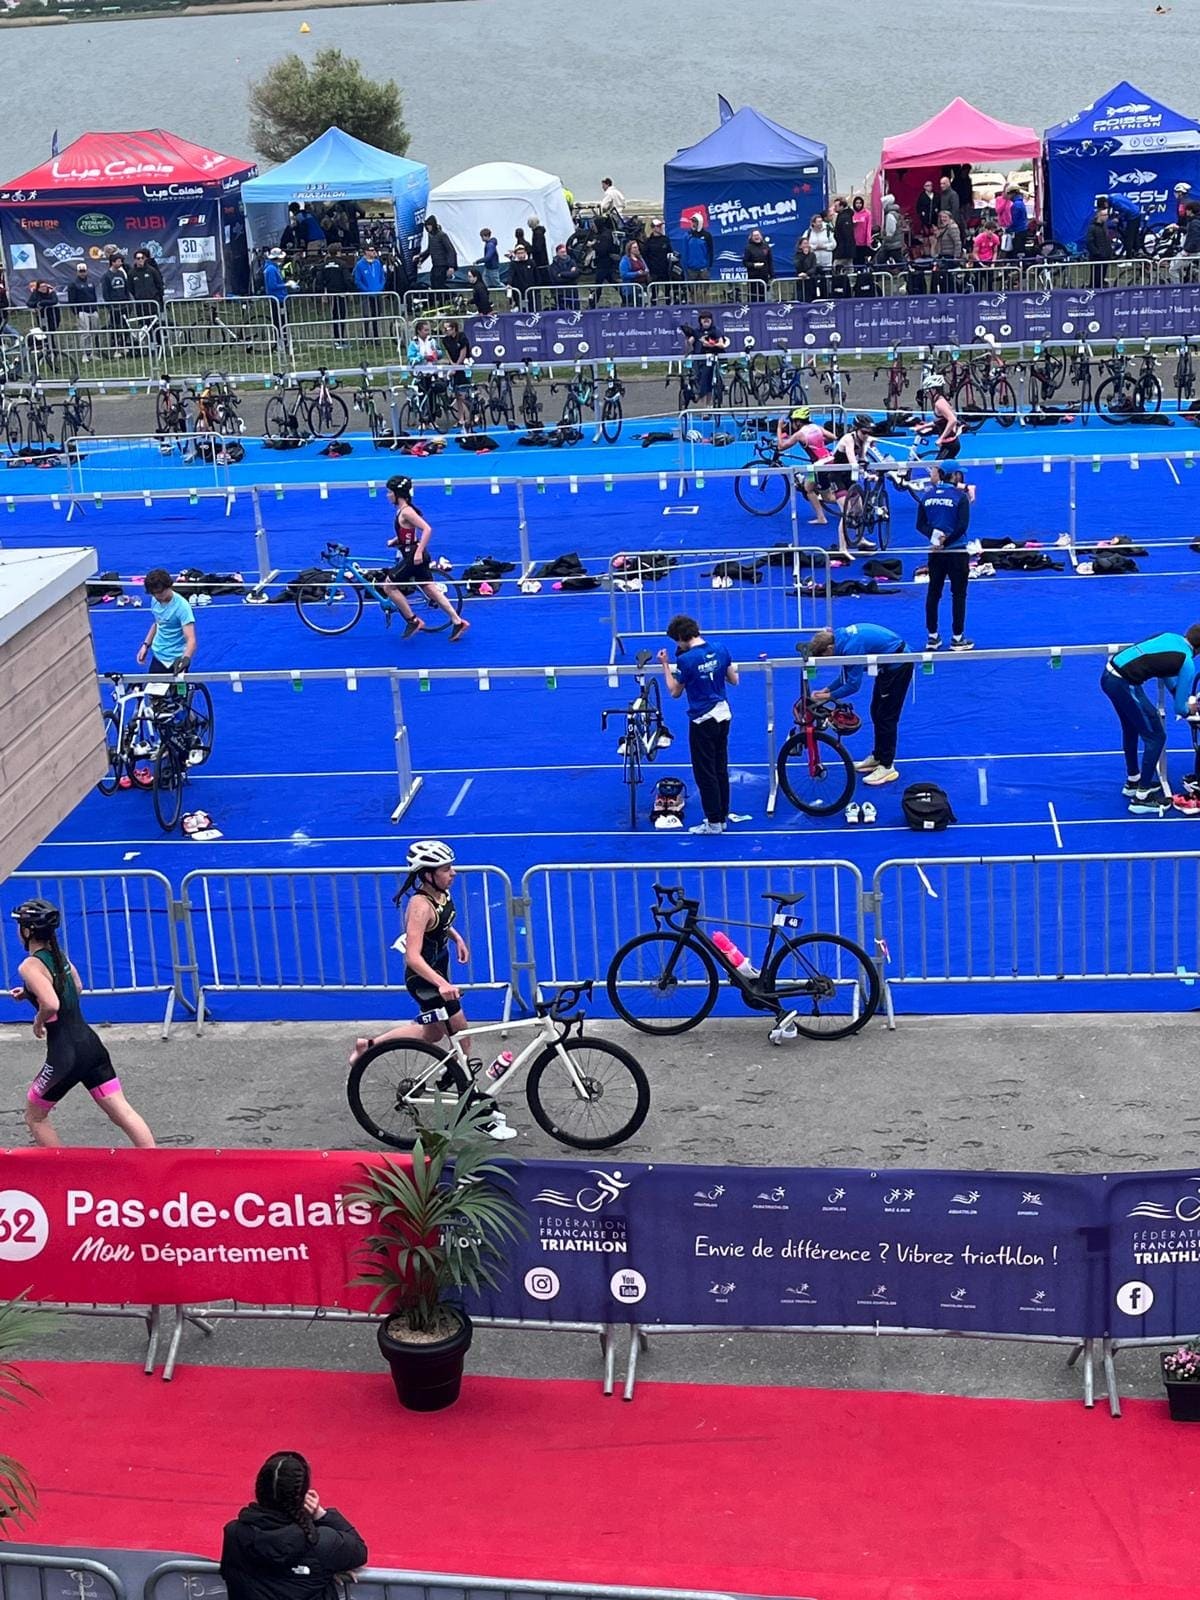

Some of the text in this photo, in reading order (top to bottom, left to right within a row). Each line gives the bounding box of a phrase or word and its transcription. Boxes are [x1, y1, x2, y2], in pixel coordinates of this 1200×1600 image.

[1093, 114, 1162, 127] POISSY
[1093, 122, 1161, 132] TRIATHLON
[52, 162, 100, 178] Lys
[104, 161, 174, 174] Calais
[143, 184, 203, 197] Lys Calais
[708, 199, 742, 214] ÉCOLE
[717, 199, 797, 226] TRIATHLON
[125, 215, 167, 229] RUBI
[182, 240, 197, 253] 3D
[924, 498, 954, 507] OFFICIEL
[422, 1013, 432, 1024] 57
[539, 1216, 626, 1230] FÉDÉRATION
[540, 1228, 627, 1240] FRANÇAISE DE
[72, 1237, 309, 1266] Mon Département
[540, 1239, 627, 1253] TRIATHLON
[695, 1235, 1058, 1266] Envie de différence ? Vibrez triathlon !
[621, 1274, 635, 1285] You
[621, 1286, 639, 1297] Tube
